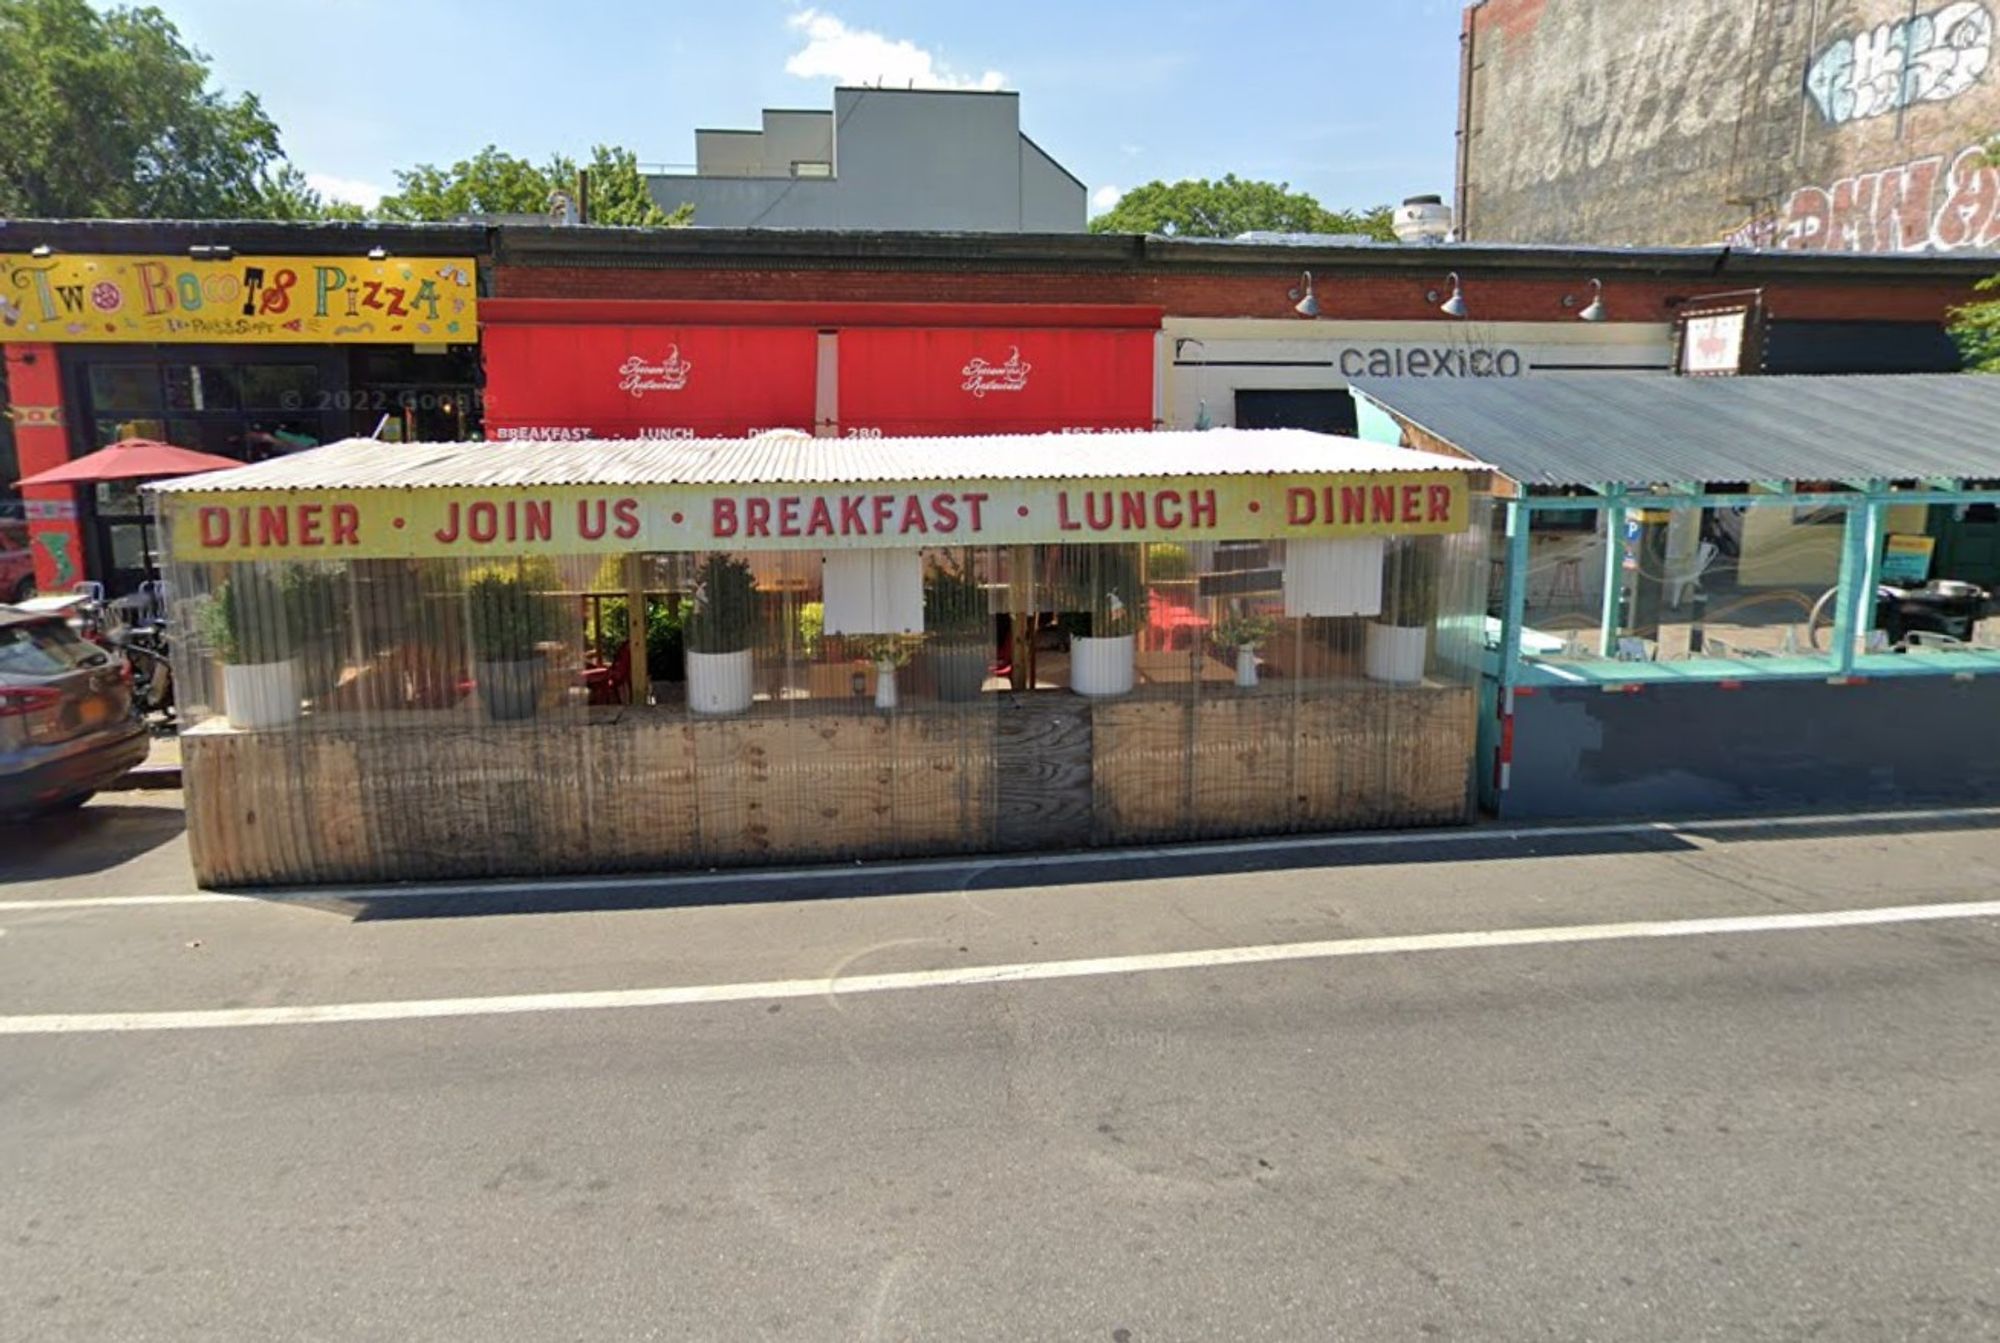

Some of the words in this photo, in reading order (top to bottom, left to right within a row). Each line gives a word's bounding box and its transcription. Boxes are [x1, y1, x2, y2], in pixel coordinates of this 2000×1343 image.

[1339, 345, 1520, 378] calexico
[497, 428, 591, 440] BREAKFAST
[639, 428, 695, 440] LUNCH
[200, 505, 361, 547] DINER
[434, 501, 553, 544] JOIN
[577, 498, 641, 540] US
[712, 493, 990, 537] BREAKFAST
[1058, 488, 1218, 530] LUNCH
[1287, 484, 1452, 525] DINNER
